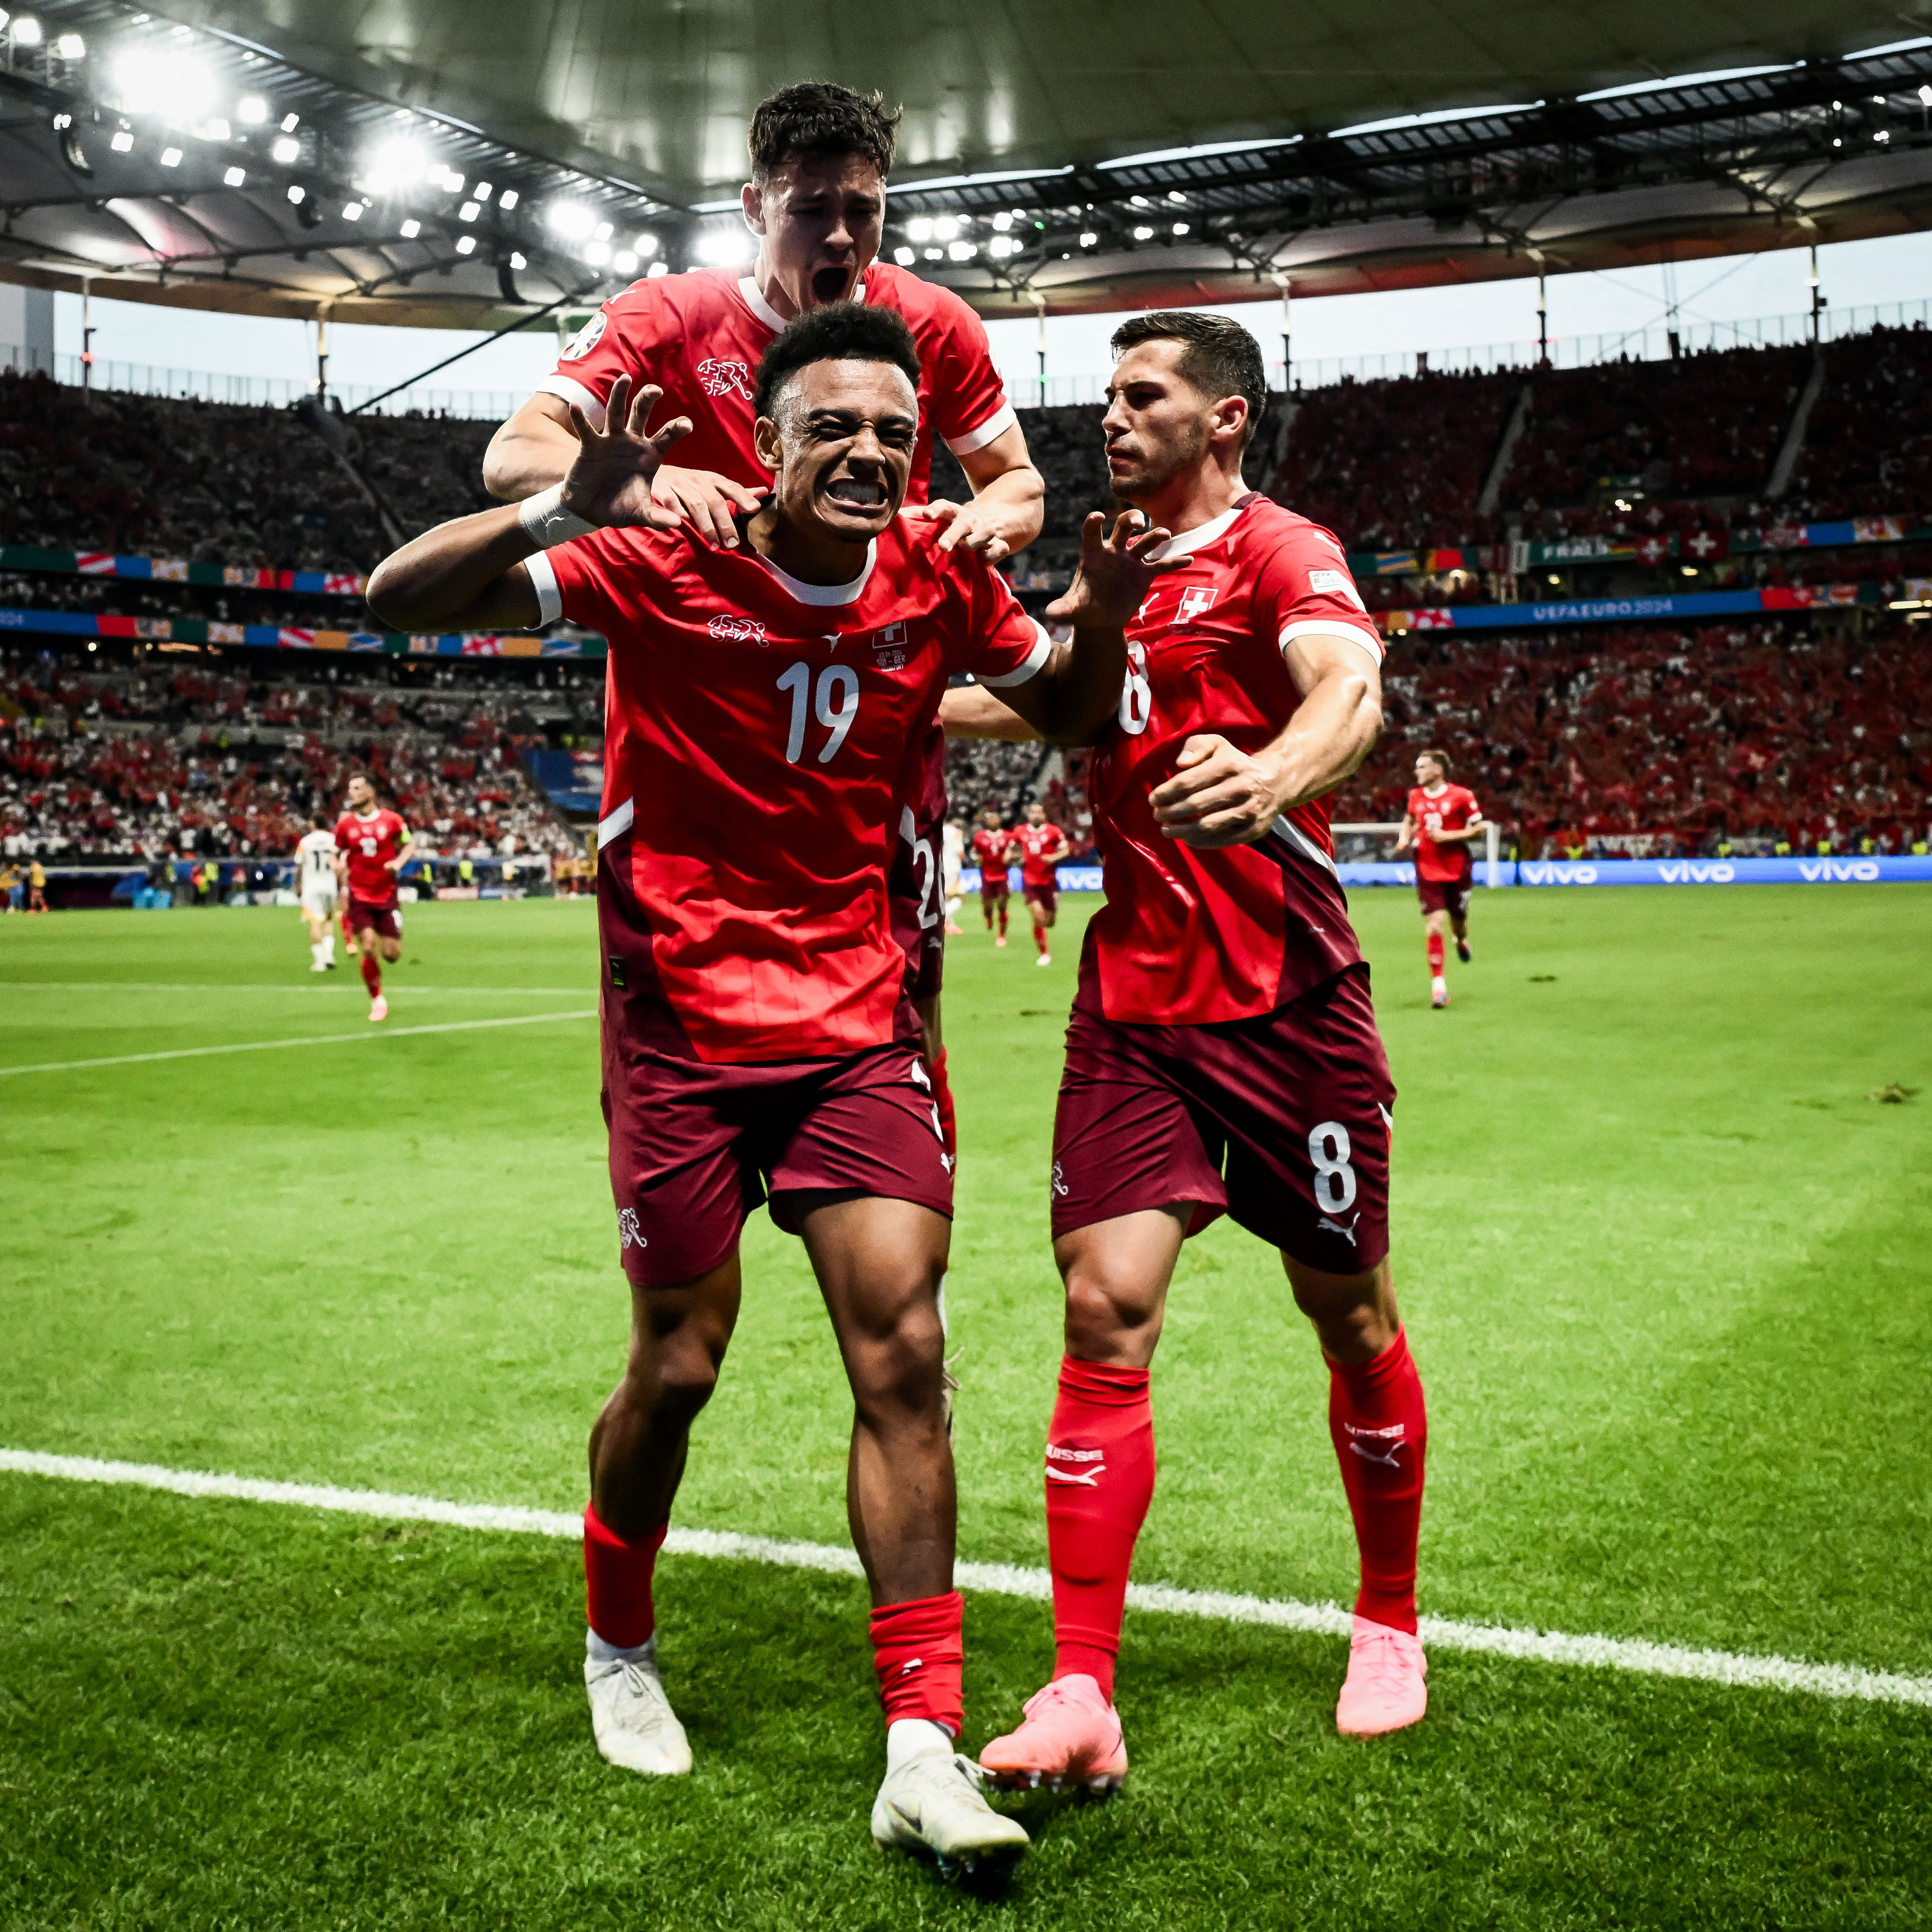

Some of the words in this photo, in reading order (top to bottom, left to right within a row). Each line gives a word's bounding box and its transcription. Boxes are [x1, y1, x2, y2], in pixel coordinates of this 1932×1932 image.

[894, 655, 906, 664] GER
[1118, 640, 1151, 734] 8
[776, 661, 859, 763] 19
[1056, 866, 1103, 890] ivo
[1524, 863, 1598, 884] vivo
[1658, 860, 1735, 883] vivo
[1798, 858, 1880, 881] vivo
[1309, 1121, 1356, 1213] 8
